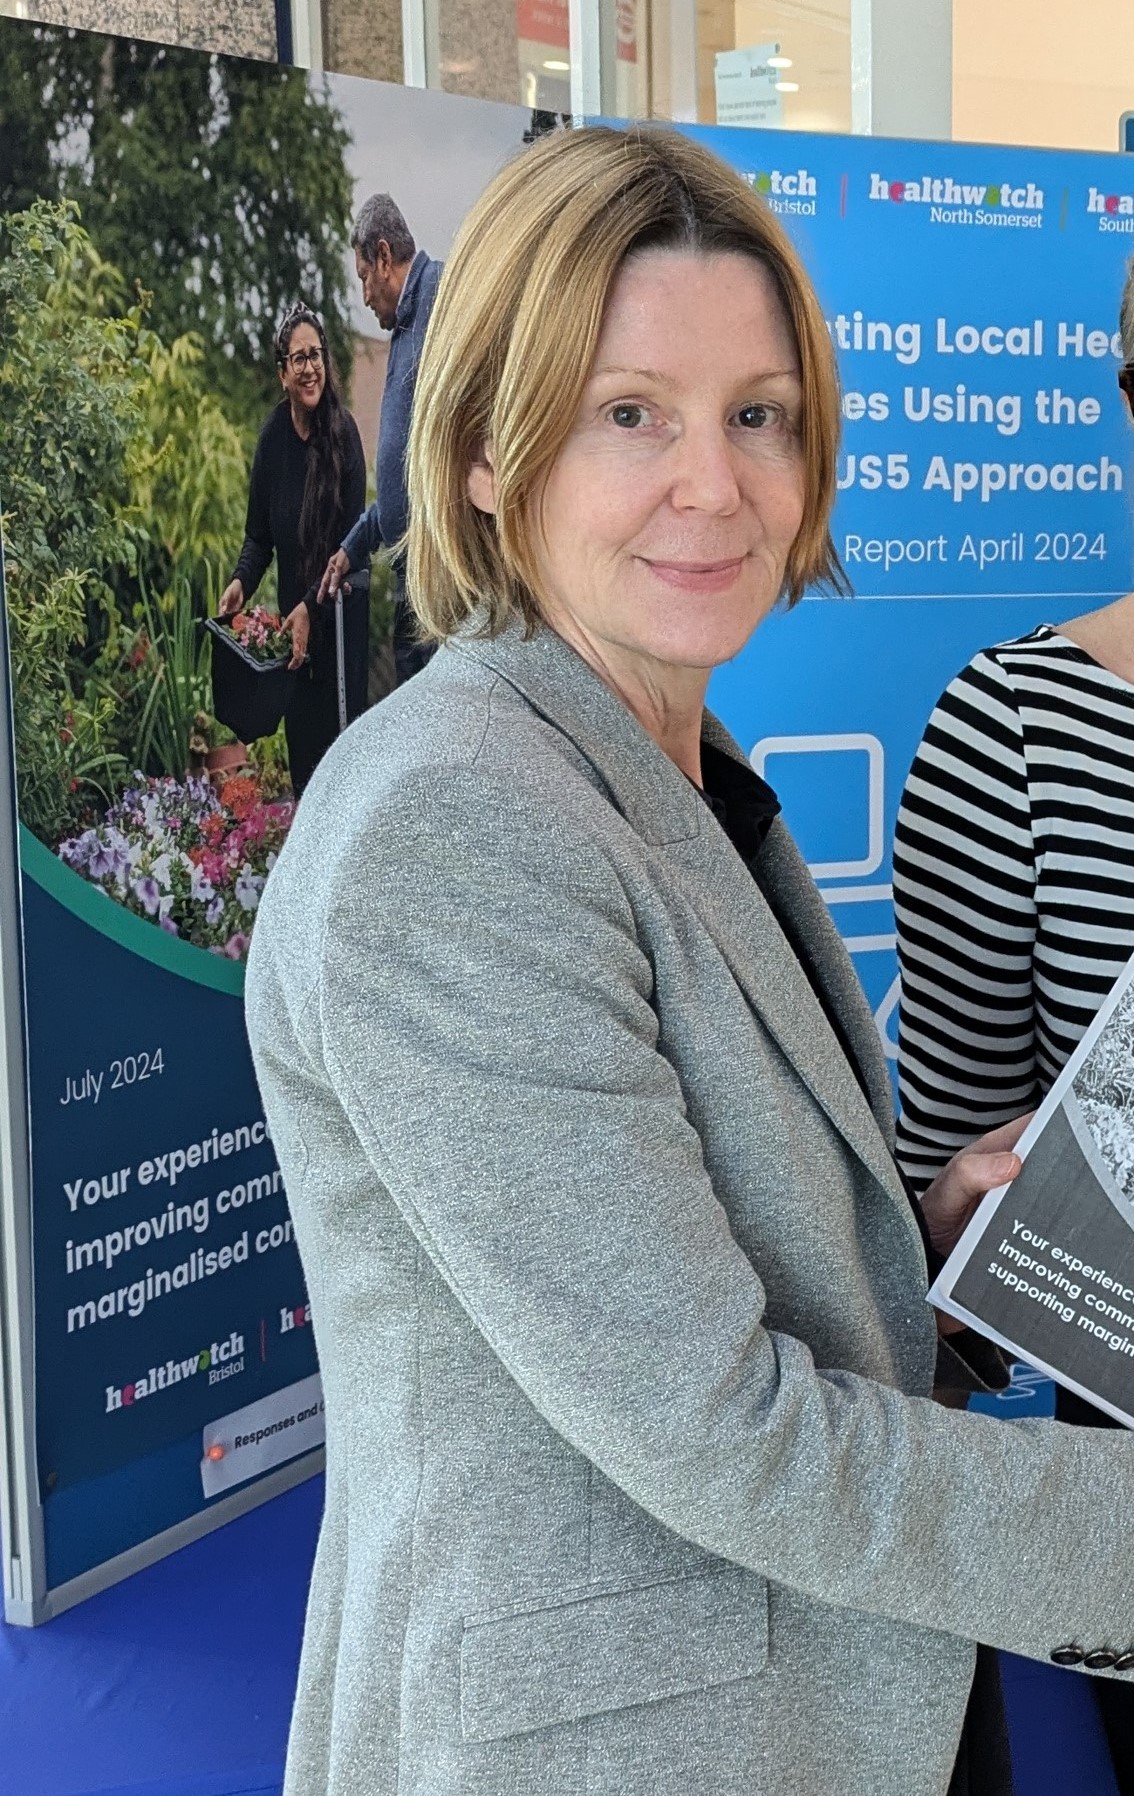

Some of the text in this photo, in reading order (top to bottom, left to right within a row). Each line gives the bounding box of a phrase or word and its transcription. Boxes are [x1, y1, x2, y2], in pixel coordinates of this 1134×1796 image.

[869, 173, 1044, 209] healthwatch
[930, 207, 1042, 229] North Somerset
[826, 311, 921, 364] ting
[937, 318, 1043, 357] Local
[842, 384, 1101, 435] es Using the
[923, 456, 1123, 502] Approach
[845, 533, 1107, 571] Report April 2024
[60, 1047, 165, 1106] July 2024
[63, 1120, 272, 1212] Your experienc
[65, 1196, 209, 1275] improving
[1011, 1219, 1050, 1251] Your
[67, 1231, 249, 1334] marginalised
[987, 1262, 1076, 1322] supporting
[998, 1239, 1082, 1300] improving
[105, 1332, 245, 1413] healthwatch
[208, 1357, 245, 1386] Bristol
[234, 1414, 296, 1450] Responses
[297, 1402, 318, 1423] and
